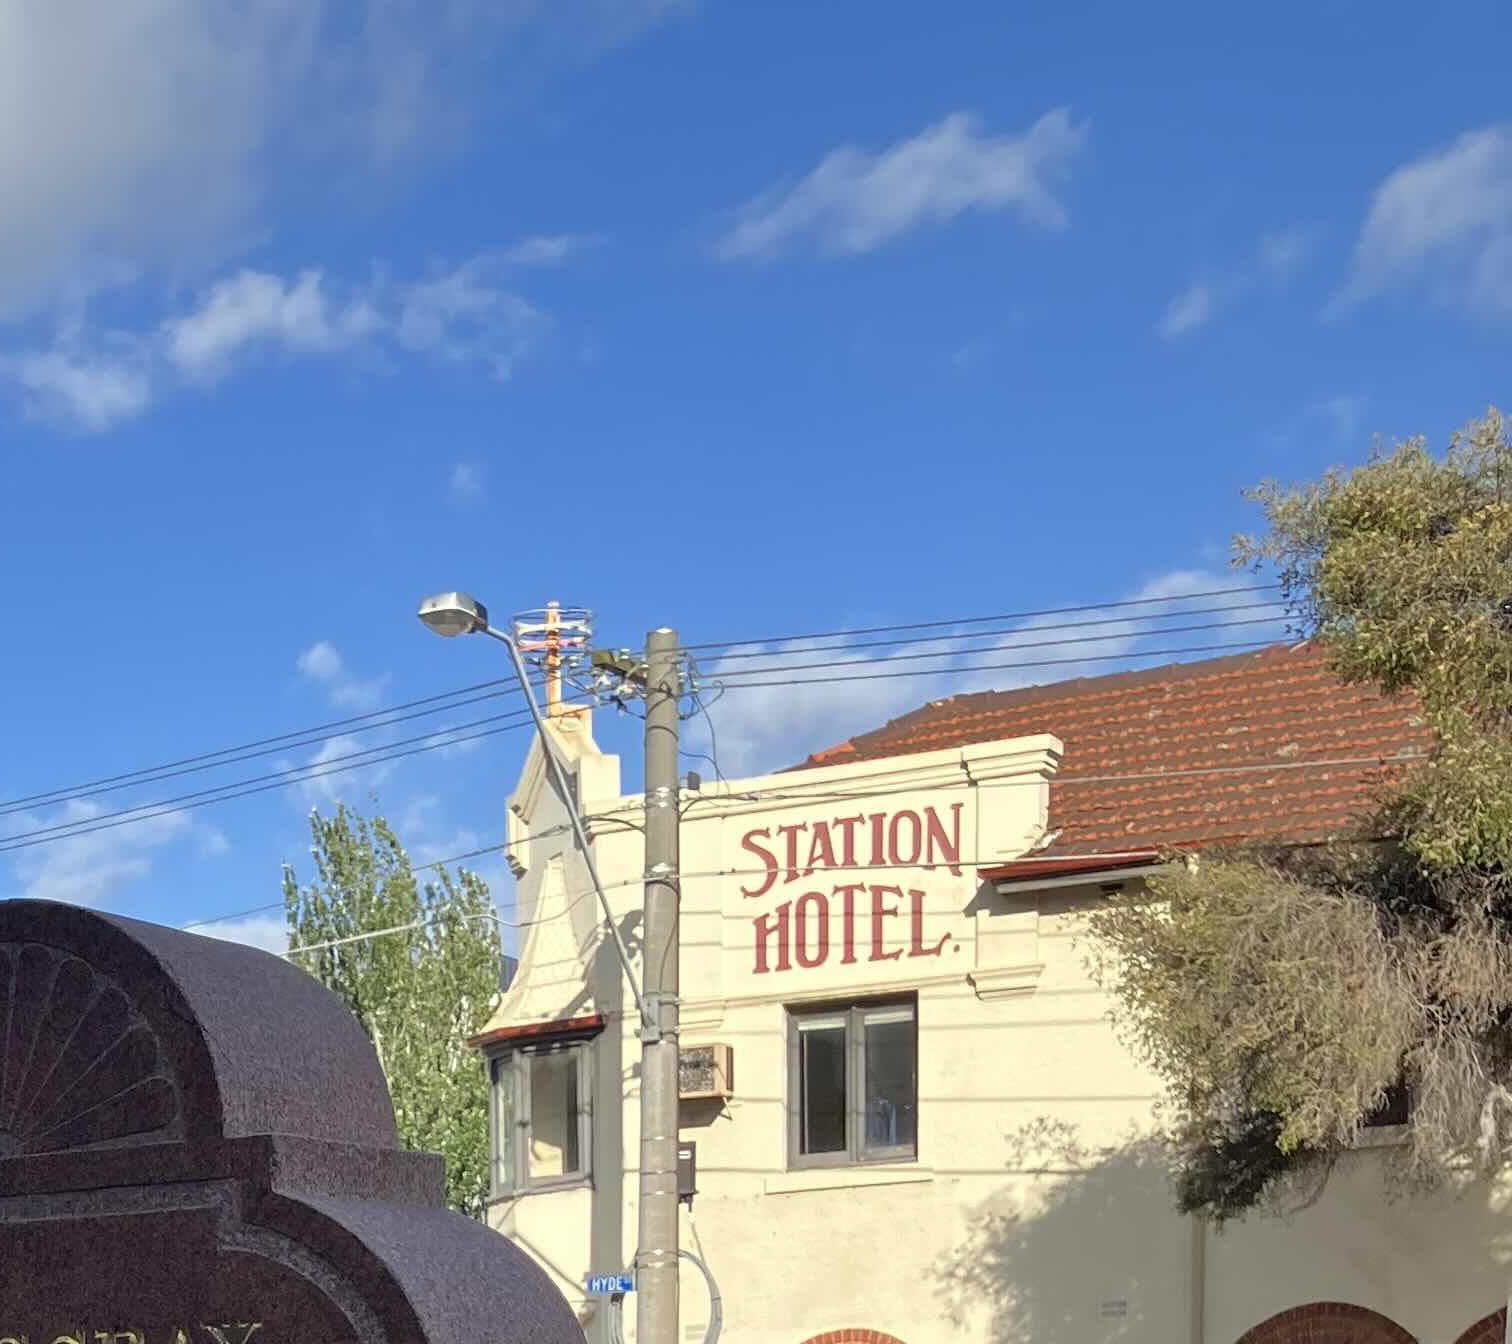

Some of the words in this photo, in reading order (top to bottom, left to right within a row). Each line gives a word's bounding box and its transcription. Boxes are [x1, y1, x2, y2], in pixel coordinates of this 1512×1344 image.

[741, 802, 964, 899] STATION
[752, 881, 961, 974] HOTEL.
[591, 1275, 624, 1292] HYDE
